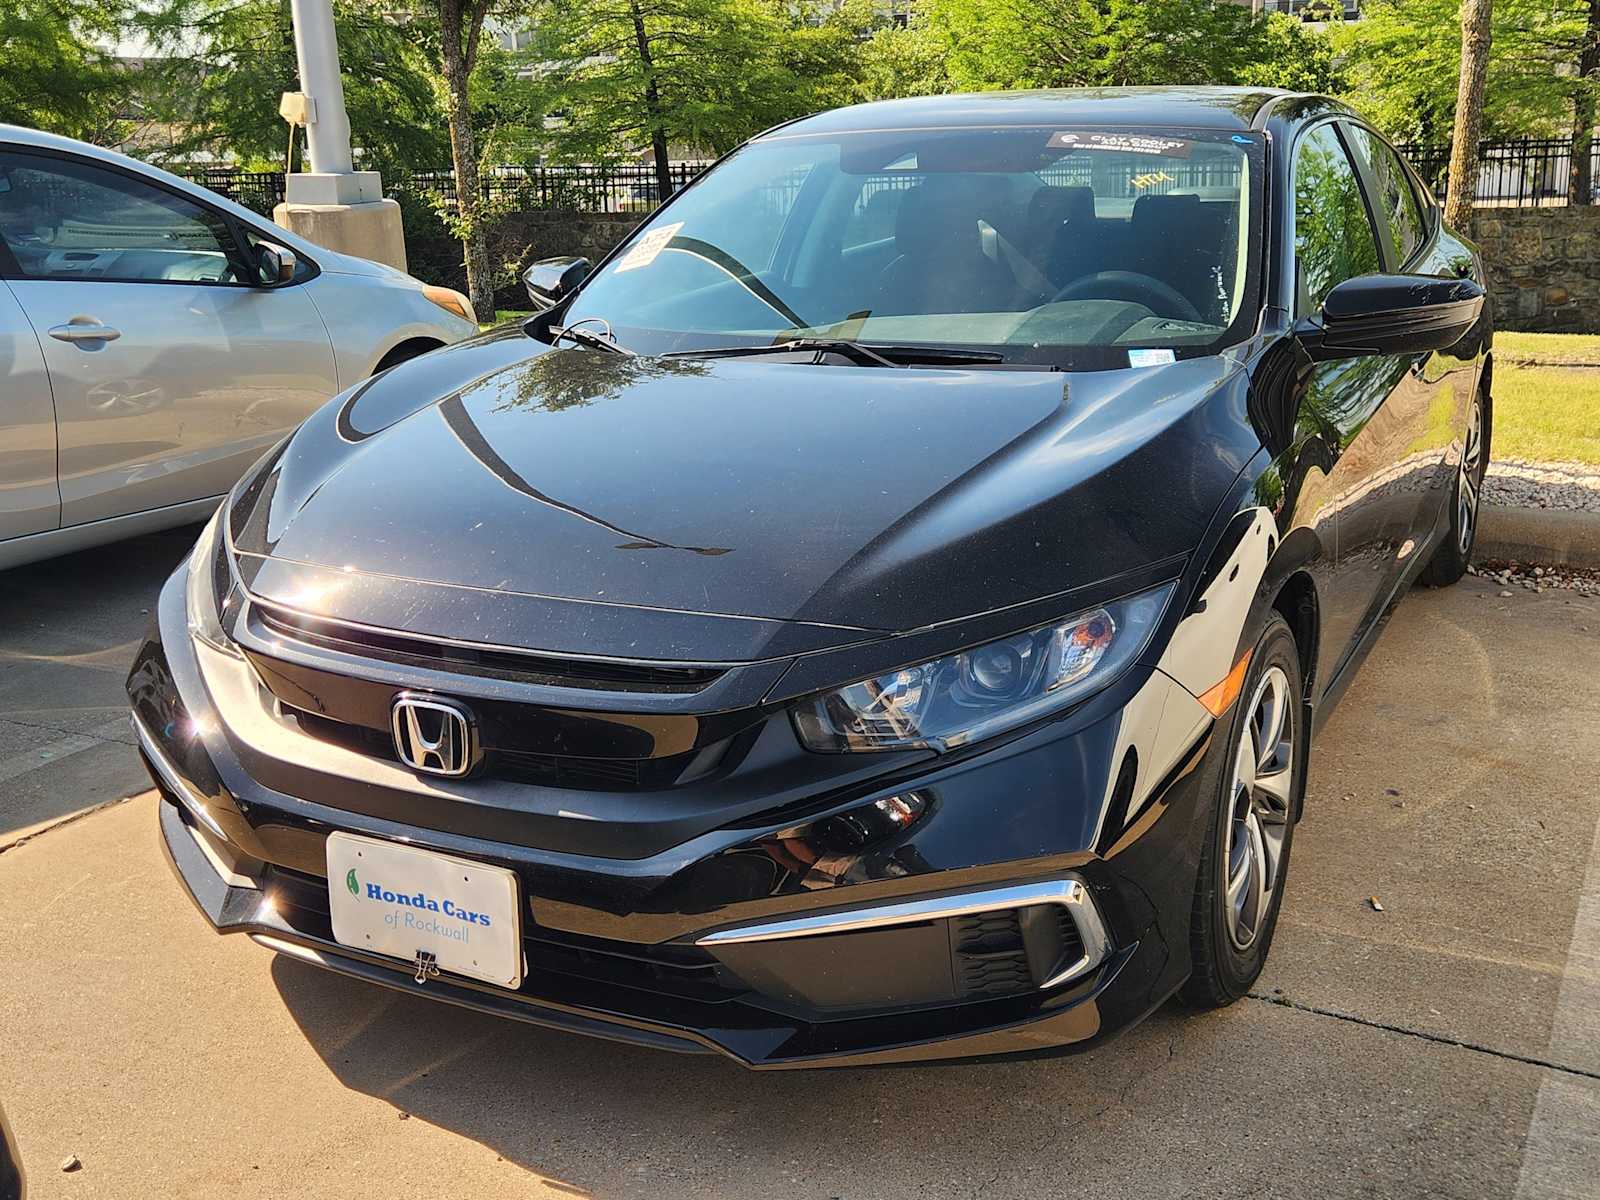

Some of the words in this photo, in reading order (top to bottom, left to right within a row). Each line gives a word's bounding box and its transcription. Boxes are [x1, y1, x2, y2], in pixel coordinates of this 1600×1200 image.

[366, 882, 440, 913] Honda
[442, 900, 491, 927] Cars
[384, 910, 401, 930] of
[404, 911, 470, 944] Rockwall
